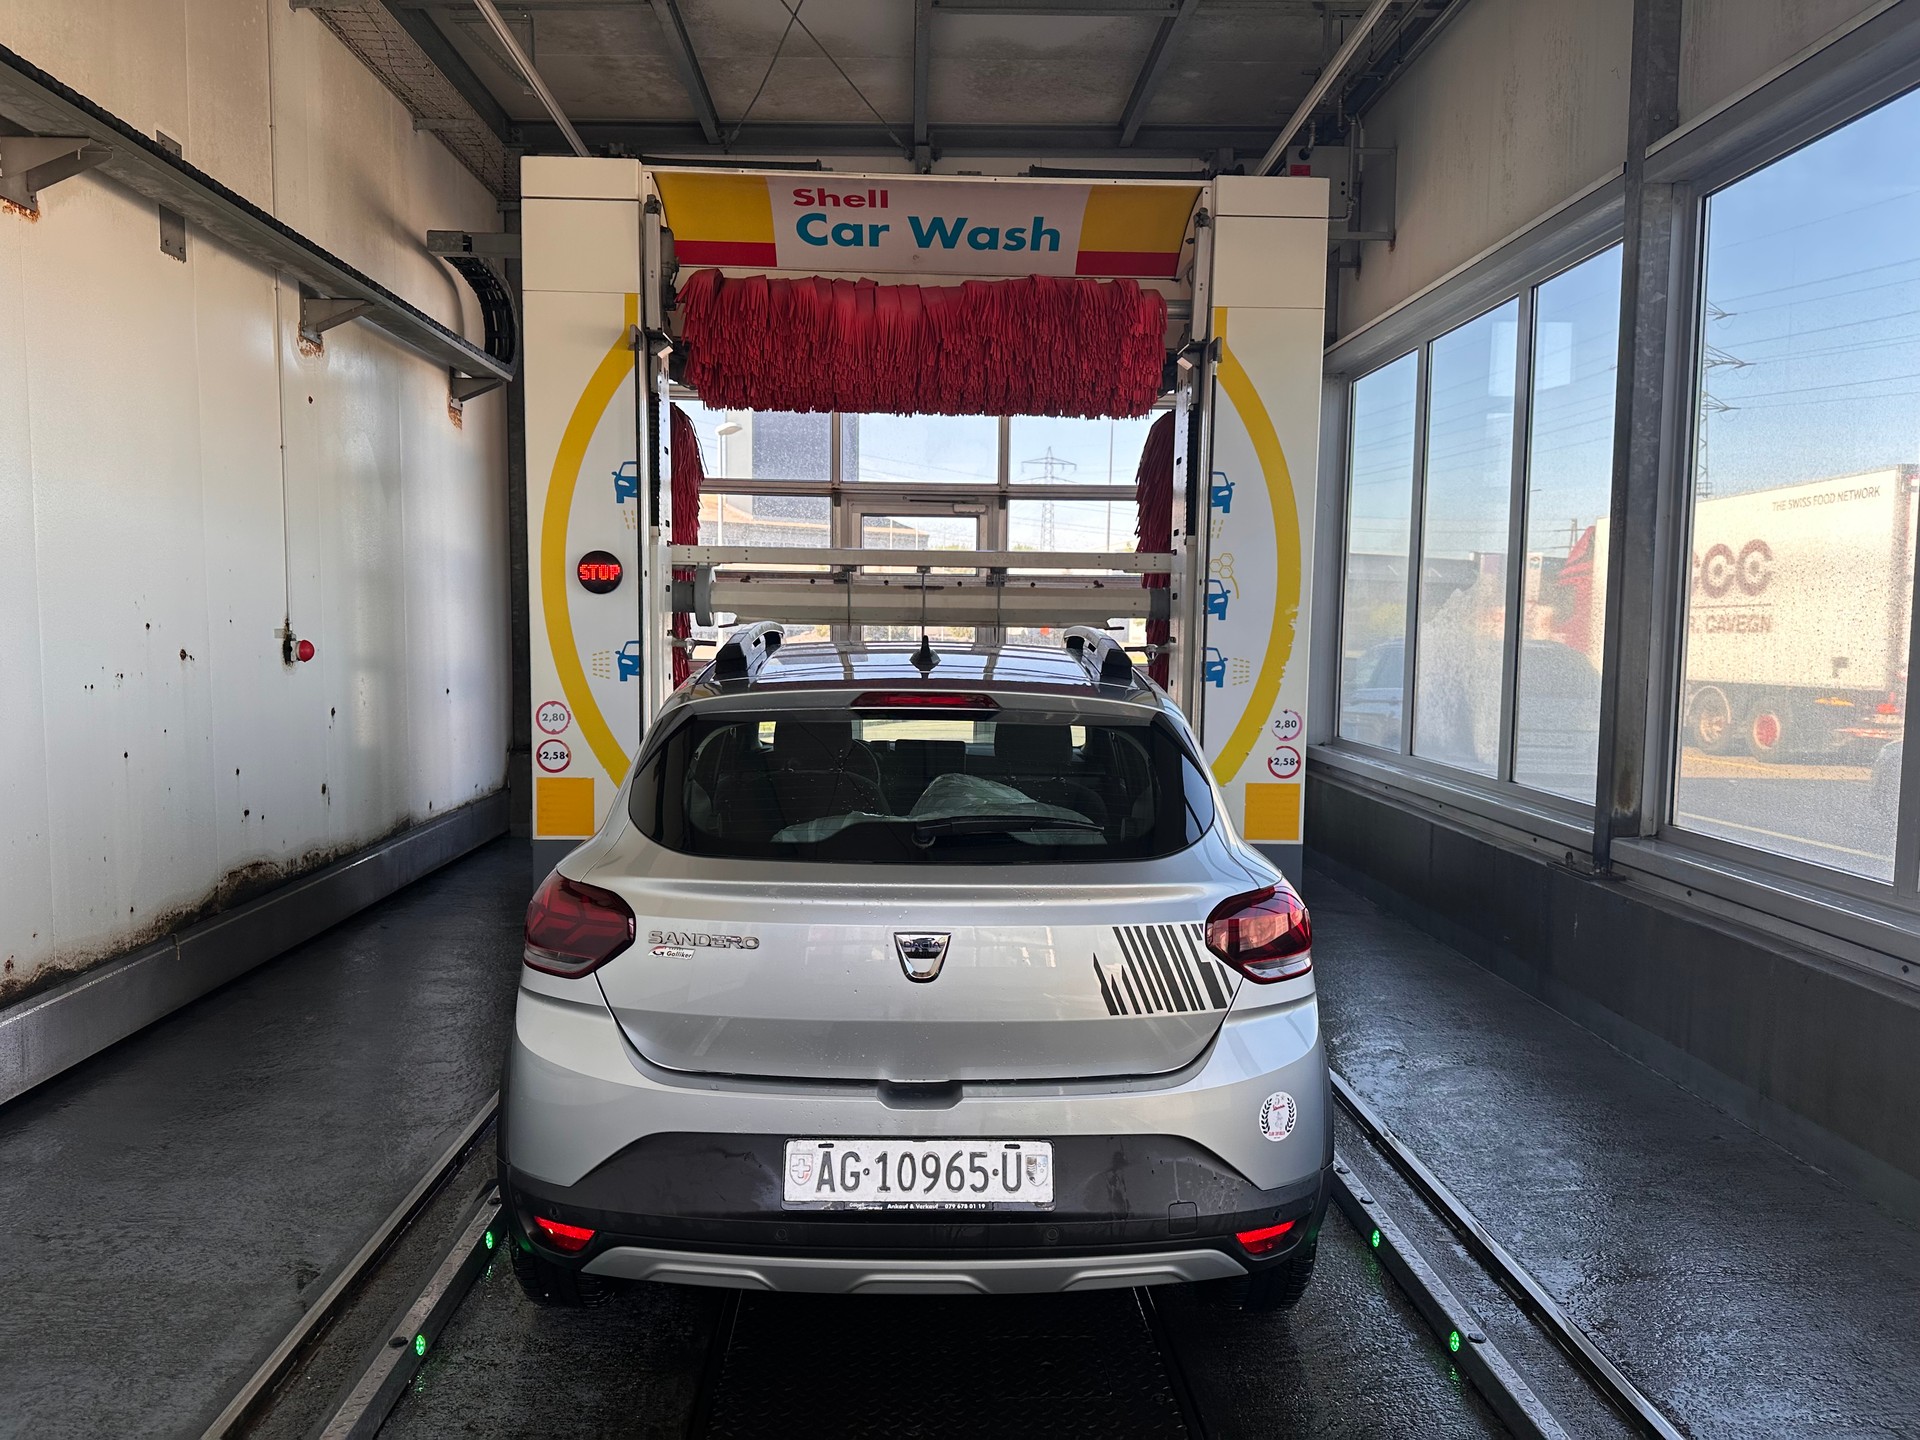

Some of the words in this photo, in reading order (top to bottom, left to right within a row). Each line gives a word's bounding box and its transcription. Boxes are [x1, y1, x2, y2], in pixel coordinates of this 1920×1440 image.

[792, 187, 889, 208] Shell
[796, 212, 890, 247] Car
[907, 216, 1061, 252] Wash
[1772, 500, 1786, 512] THE
[1788, 496, 1812, 510] SWISS
[1813, 492, 1836, 506] FOOD
[1837, 485, 1881, 502] NETWORK
[580, 564, 620, 580] STOP
[1691, 538, 1773, 599] CC
[541, 713, 566, 723] 2,80
[1274, 720, 1297, 729] 2,80
[542, 751, 566, 761] 2,58
[1273, 757, 1296, 767] 2,58
[647, 930, 760, 950] SANDERO
[903, 940, 941, 949] DACIA
